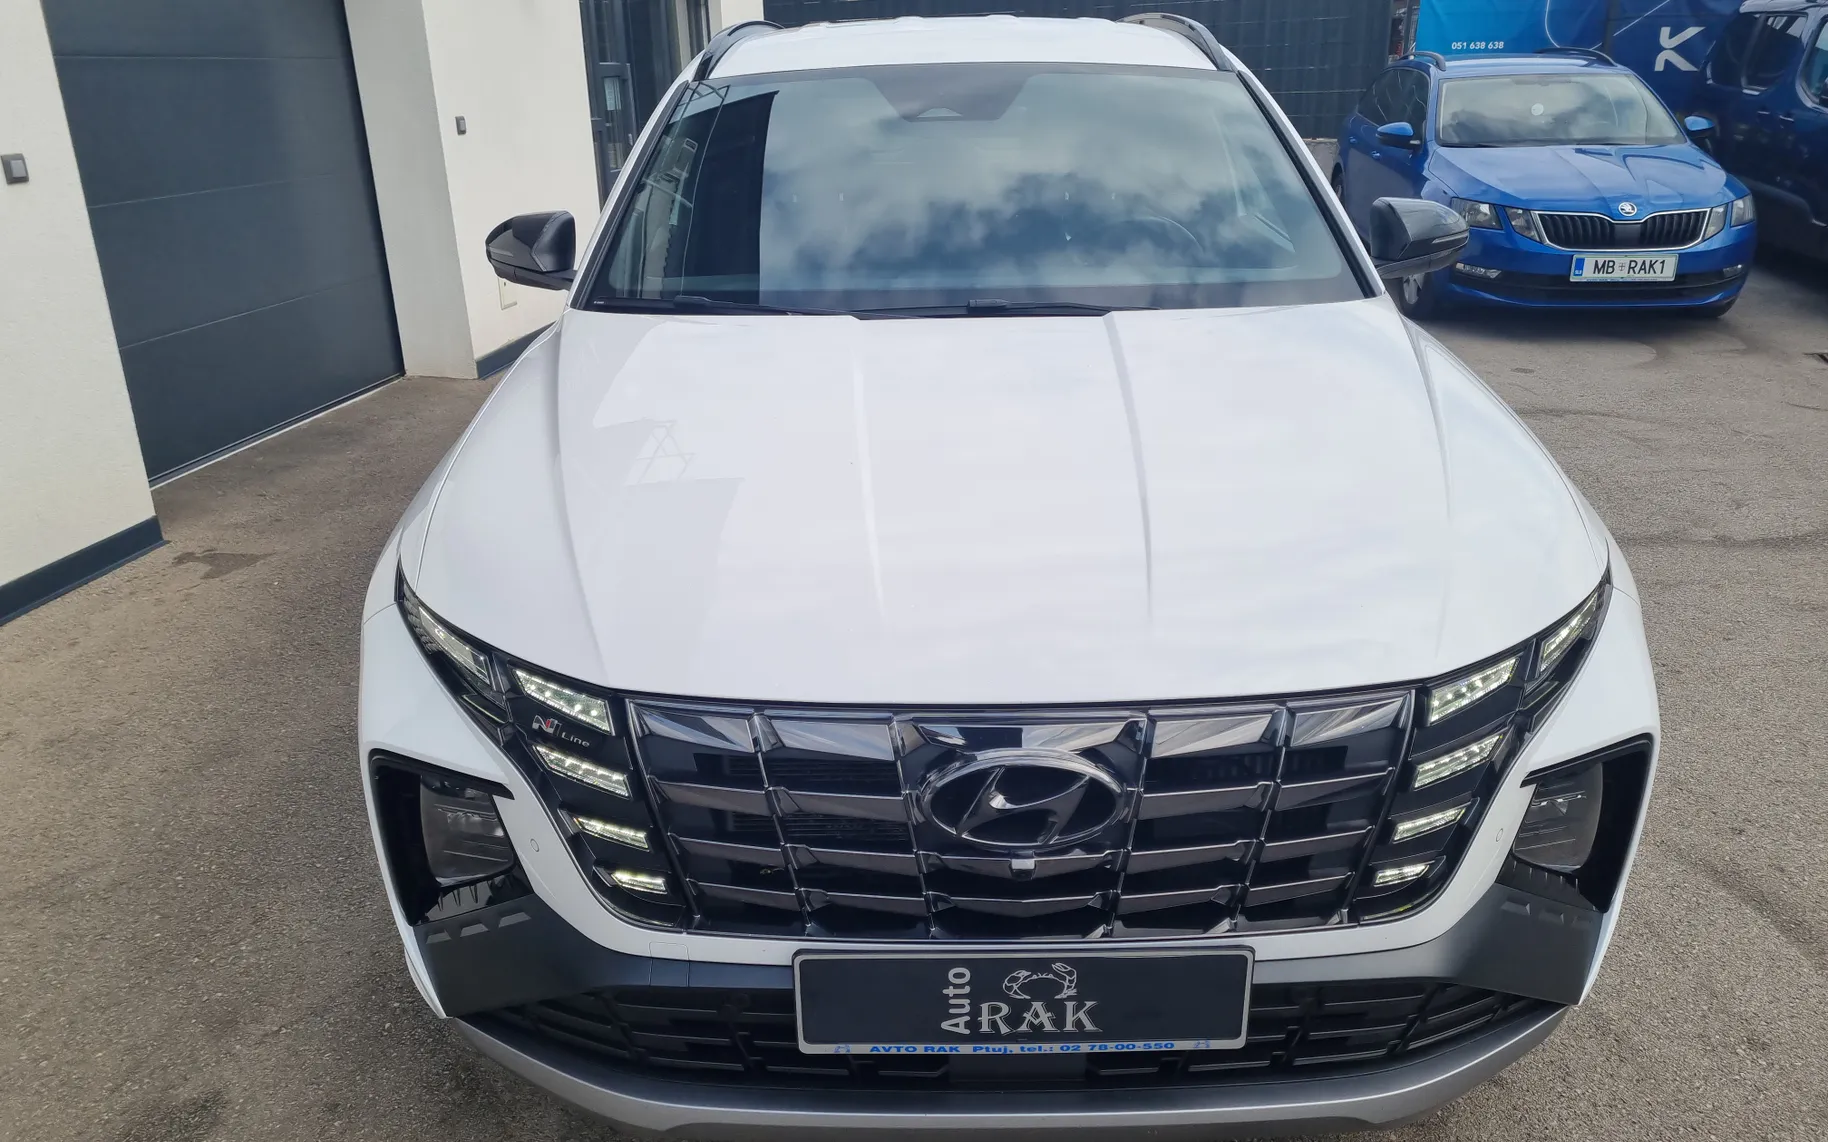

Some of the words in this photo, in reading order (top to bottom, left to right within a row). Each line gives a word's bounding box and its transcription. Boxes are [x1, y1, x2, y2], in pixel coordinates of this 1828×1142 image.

[1451, 41, 1467, 50] 051
[1470, 41, 1486, 50] 638
[1488, 41, 1505, 50] 638
[1593, 259, 1616, 275] MB
[1627, 259, 1666, 275] RAK1
[561, 731, 590, 747] Line
[940, 967, 971, 1035] Auto
[977, 1001, 1103, 1036] RAK
[869, 1045, 918, 1053] AVTO
[923, 1045, 961, 1053] RAK
[1060, 1044, 1081, 1052] 02
[1088, 1042, 1175, 1052] 78-00-550
